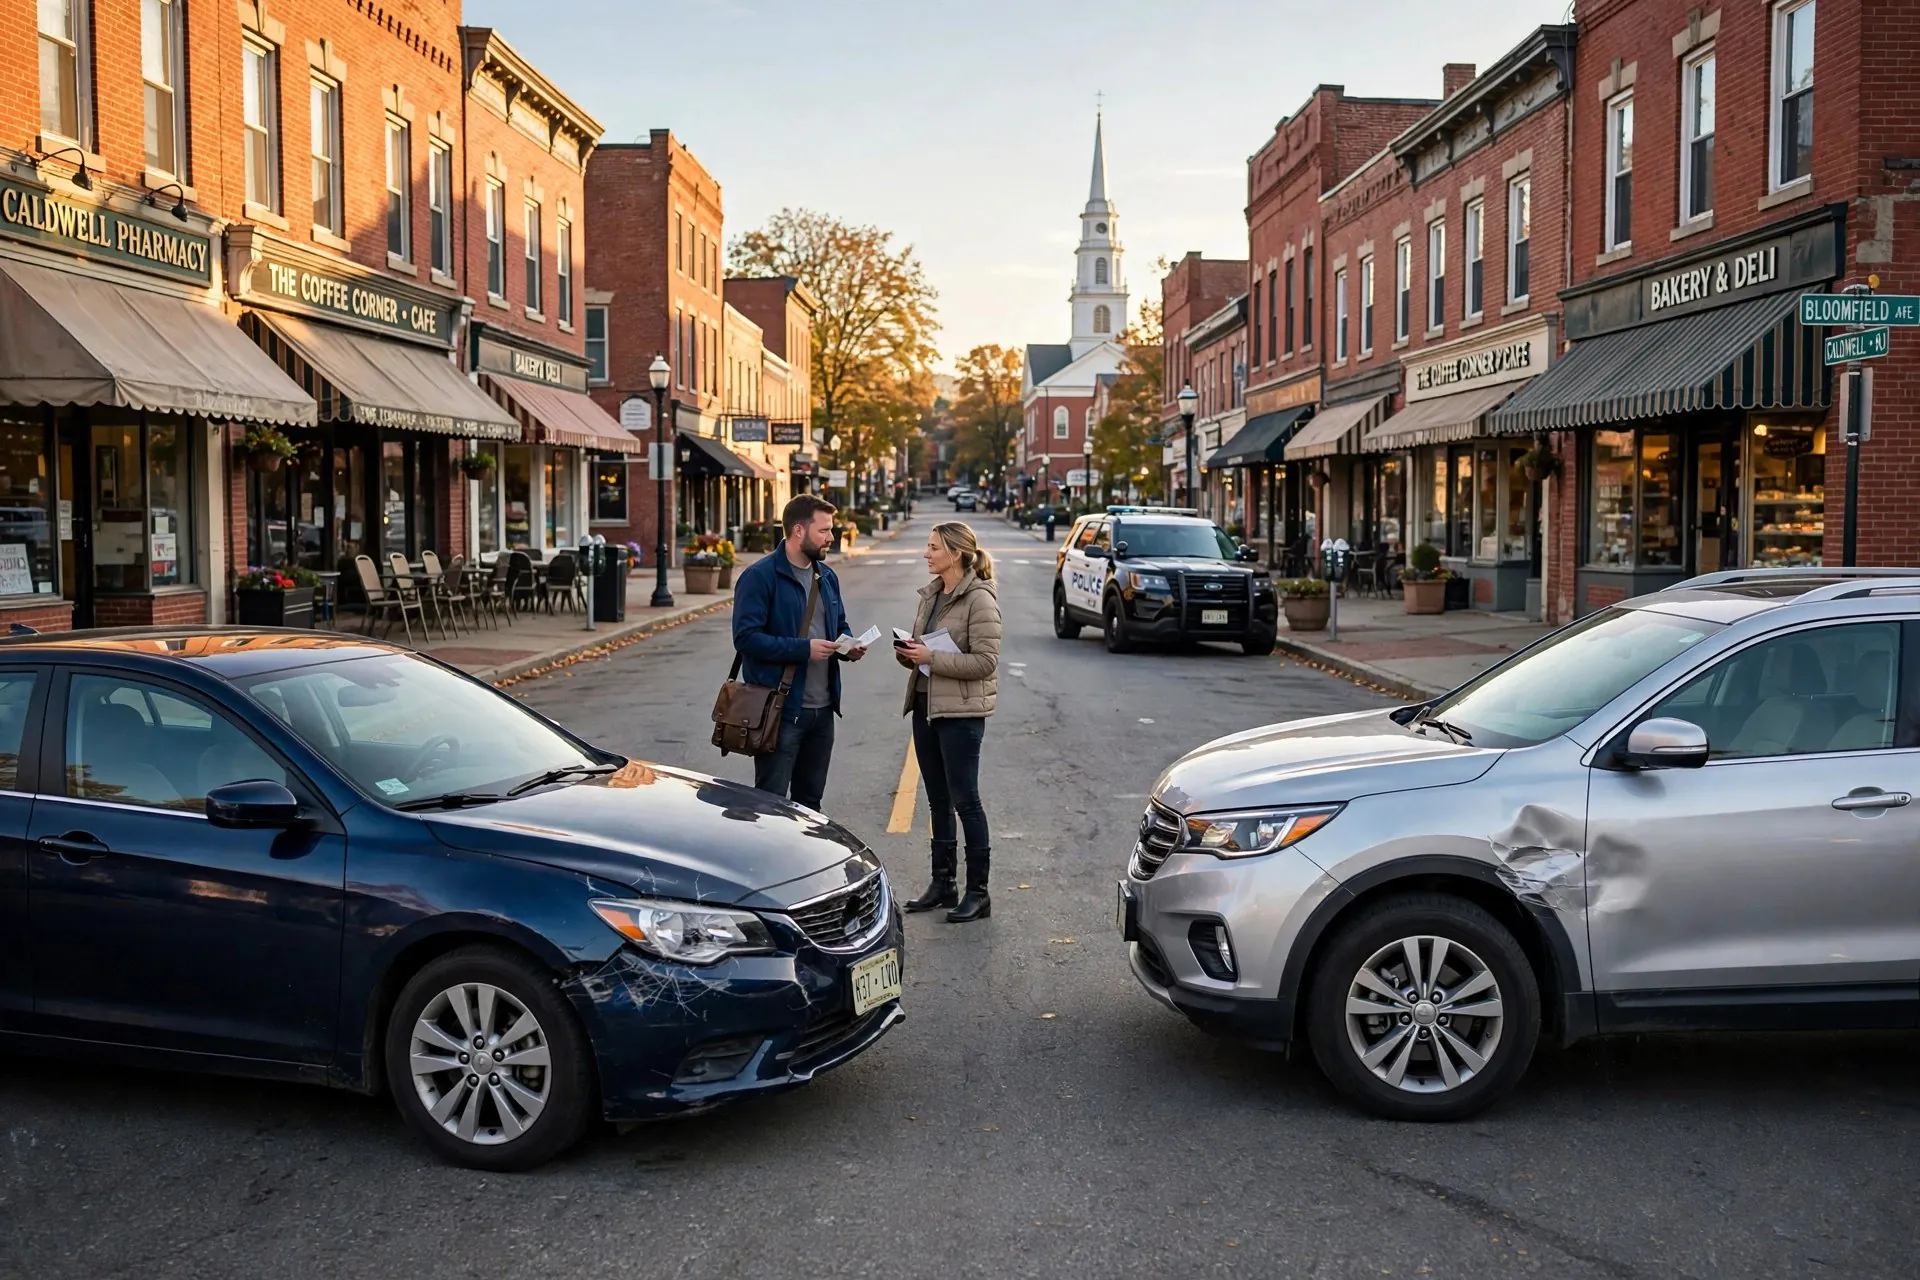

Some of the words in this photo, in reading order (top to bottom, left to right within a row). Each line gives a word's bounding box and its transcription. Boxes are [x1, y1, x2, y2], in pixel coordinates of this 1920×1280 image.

[3, 188, 111, 248] CALDWELL
[117, 220, 206, 272] PHARMACY
[268, 263, 297, 297] THE
[301, 272, 349, 311] COFFEE
[352, 288, 398, 324] CORNER
[411, 306, 436, 334] CAFE
[1651, 266, 1711, 311] BAKERY
[1715, 261, 1729, 293] &
[1735, 247, 1775, 289] DELI
[1805, 300, 1889, 321] BLOOMFIELD
[1072, 572, 1102, 596] POLICE
